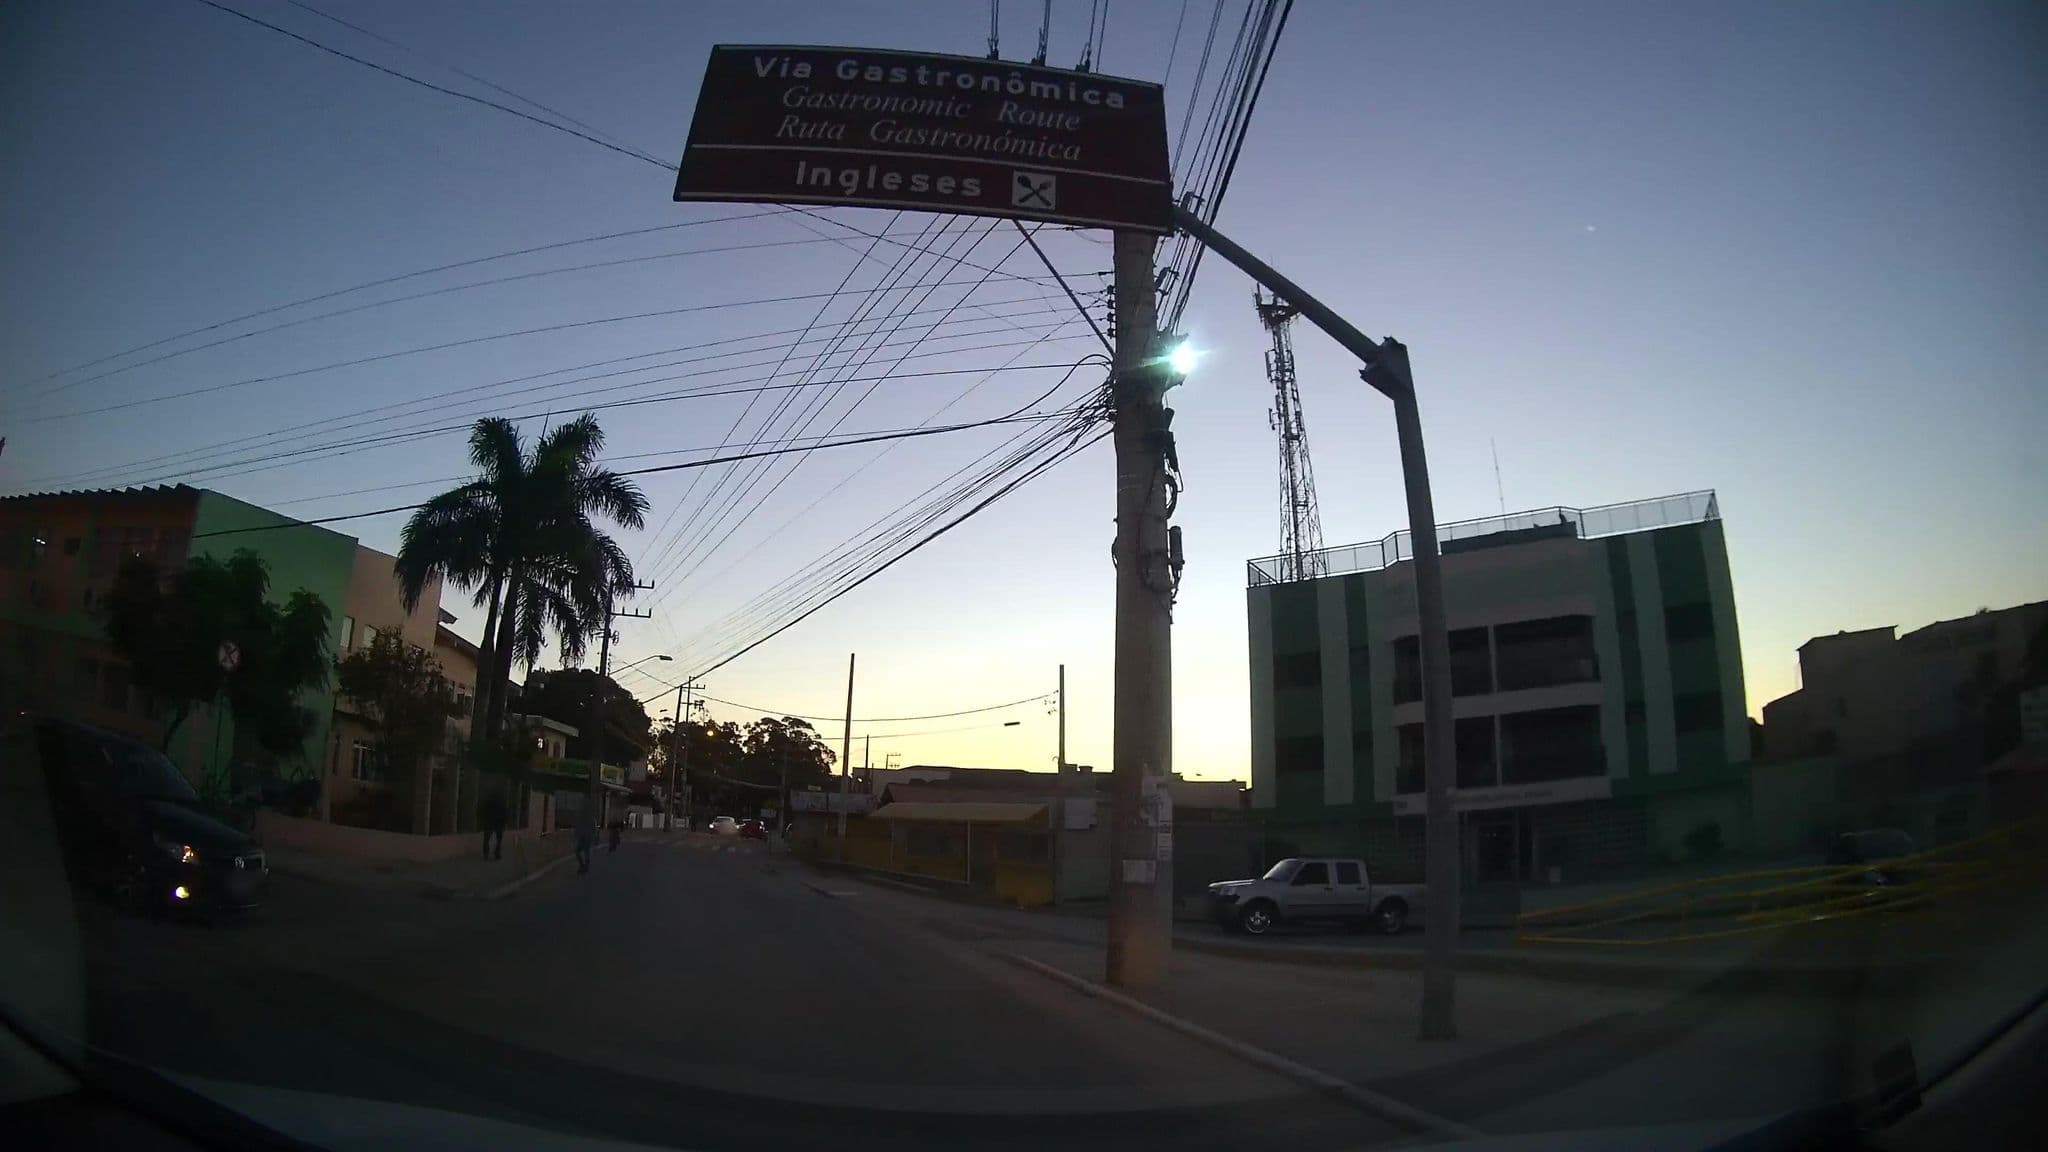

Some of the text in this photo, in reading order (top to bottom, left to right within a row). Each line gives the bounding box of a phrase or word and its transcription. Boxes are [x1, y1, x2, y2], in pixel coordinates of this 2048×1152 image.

[754, 56, 1124, 109] Via Gastronômica
[783, 85, 1080, 130] Gastronomic Route
[776, 115, 1080, 160] Ruta Gastronómica
[796, 160, 982, 197] Ingleses
